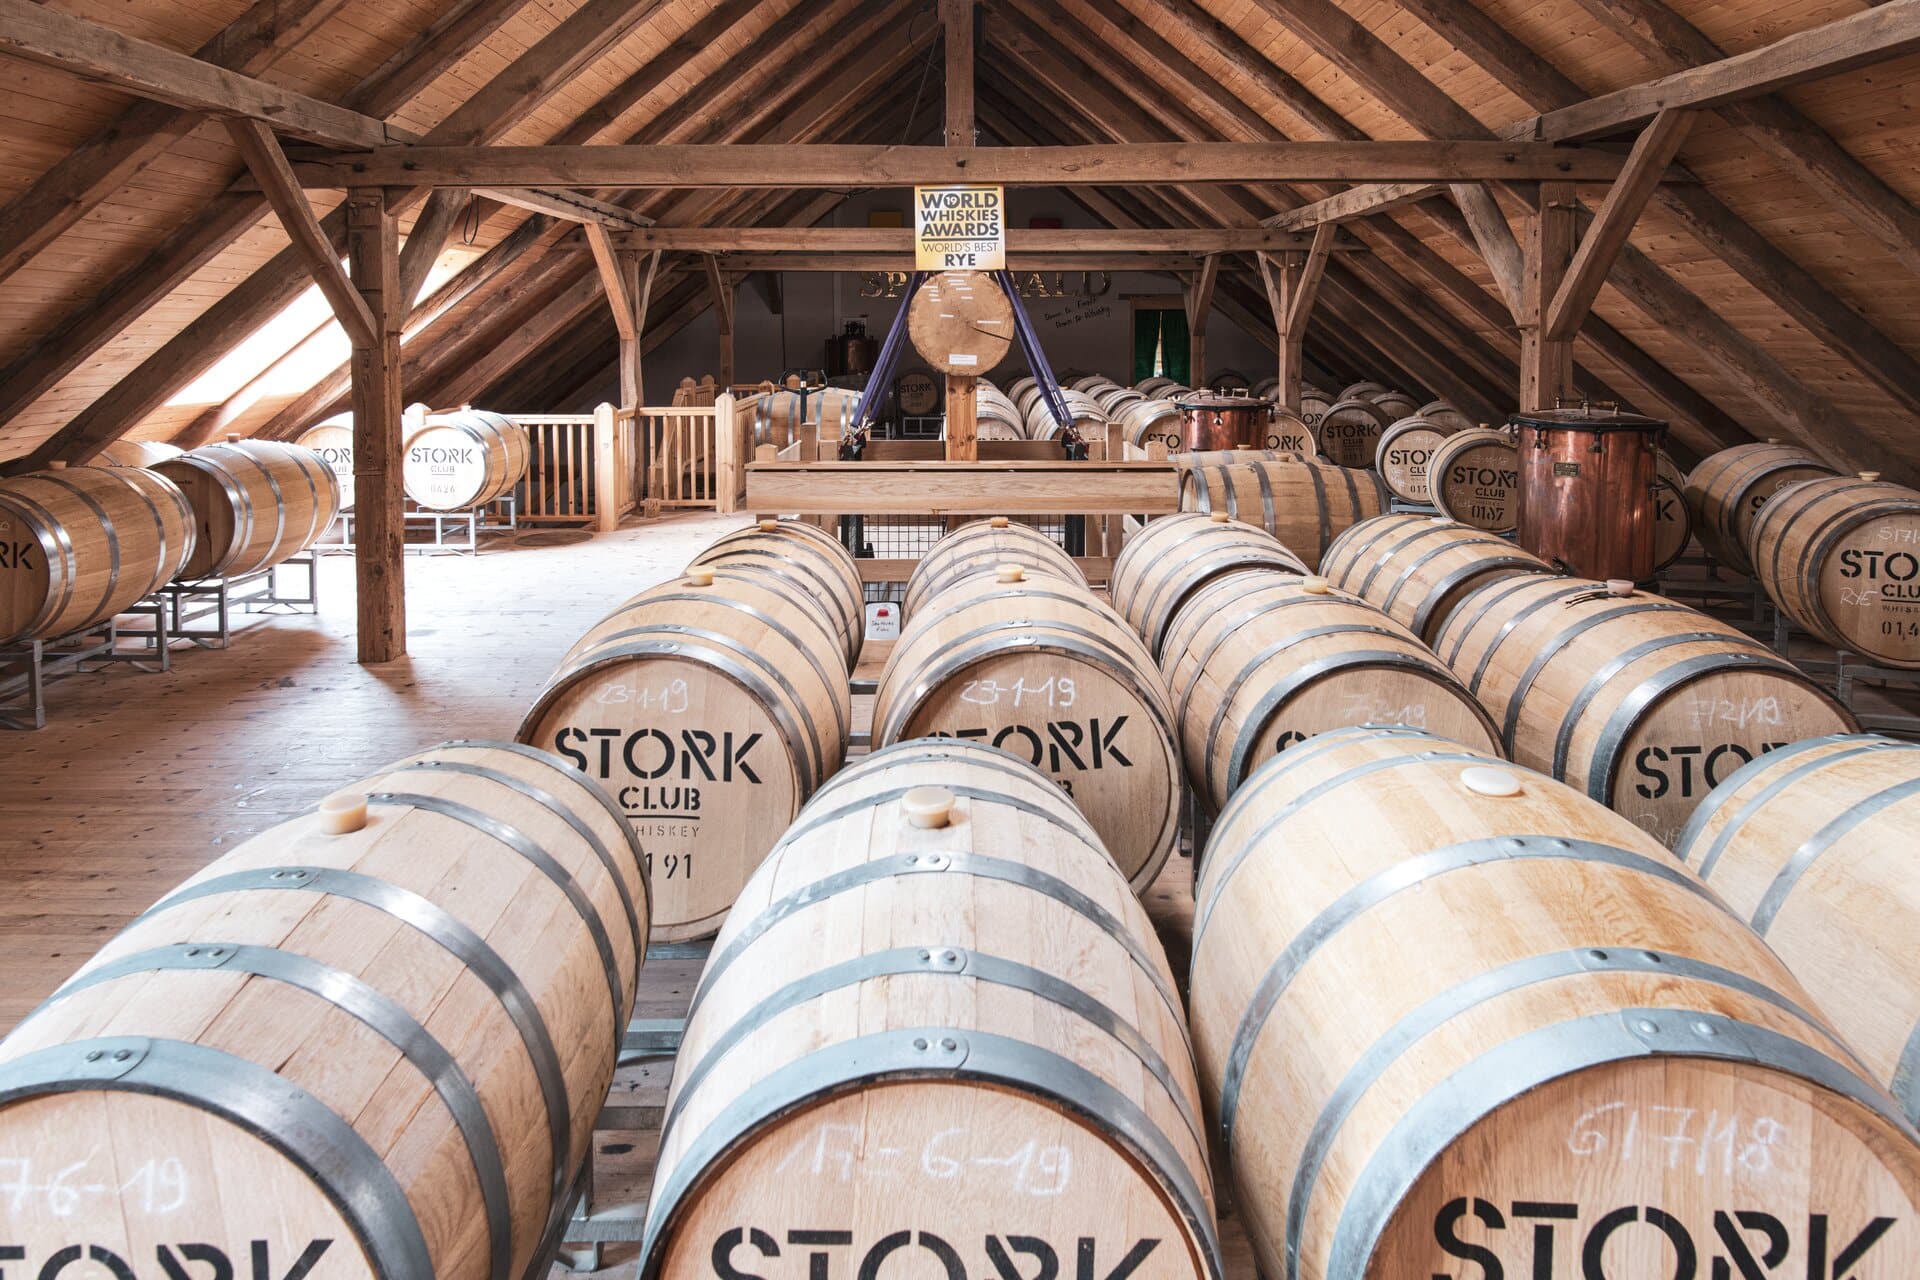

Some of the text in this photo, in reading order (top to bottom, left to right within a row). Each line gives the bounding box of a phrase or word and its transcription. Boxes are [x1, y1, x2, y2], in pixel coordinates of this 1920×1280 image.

[920, 193, 998, 208] WORLD
[921, 209, 999, 222] WHISKIES
[921, 222, 999, 237] AWARDS
[923, 242, 998, 253] WORLD'S BEST
[944, 253, 976, 267] RYE
[1326, 422, 1378, 439] STORK
[411, 448, 473, 464] STORK
[430, 465, 456, 474] CLUB
[1475, 488, 1506, 498] CLUB
[555, 727, 763, 785] STORK
[1635, 742, 1790, 800] STO
[619, 786, 701, 811] CLUB
[631, 824, 701, 839] HISKEY
[1433, 1196, 1899, 1280] STORK
